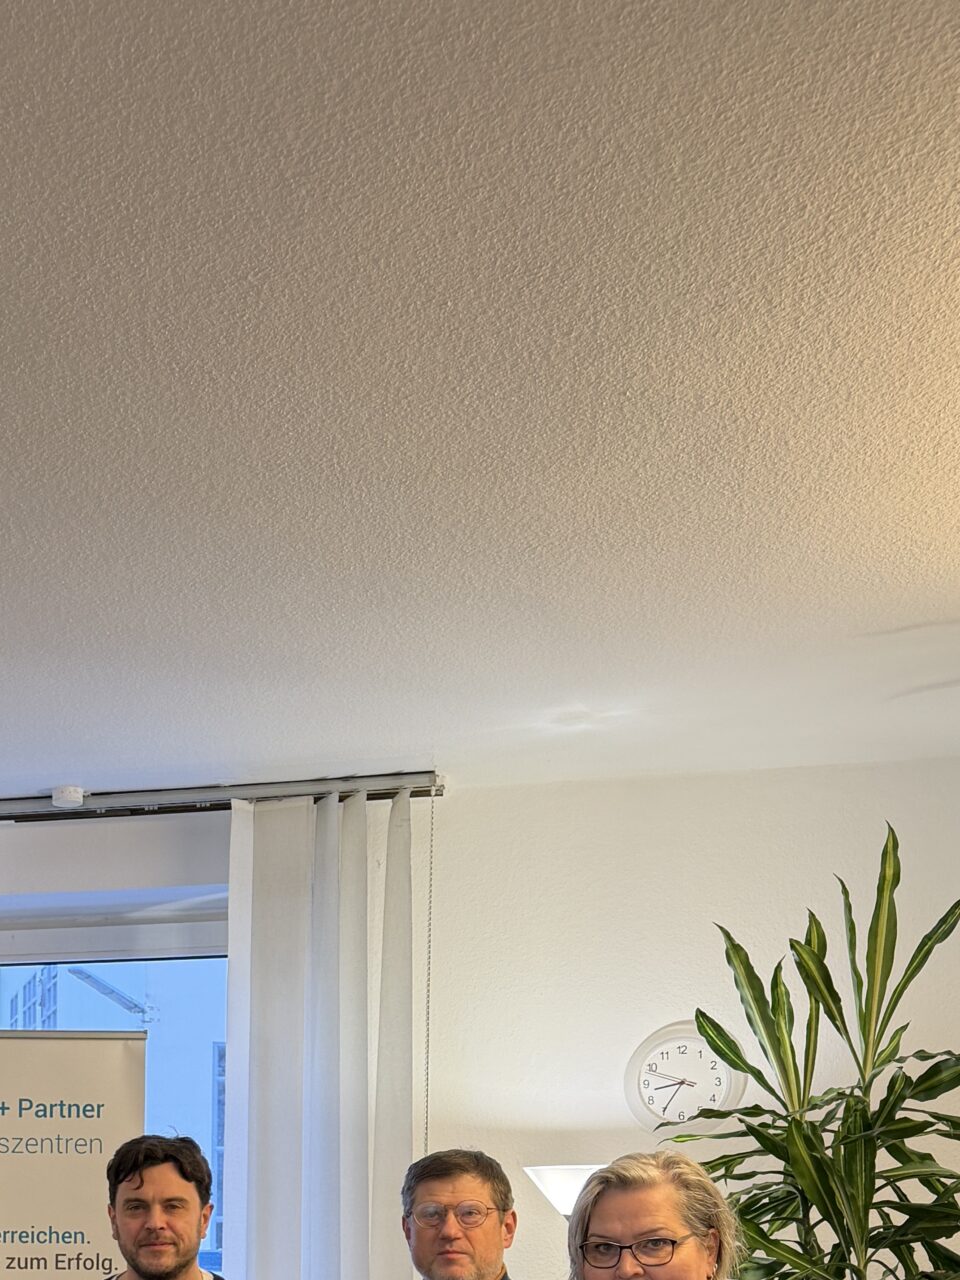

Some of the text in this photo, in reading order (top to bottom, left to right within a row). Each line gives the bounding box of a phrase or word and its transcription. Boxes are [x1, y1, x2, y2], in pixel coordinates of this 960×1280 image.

[677, 1045, 688, 1055] 12
[698, 1050, 703, 1059] 1
[660, 1051, 670, 1061] 11
[647, 1063, 658, 1073] 10
[710, 1061, 718, 1070] 2
[643, 1079, 650, 1089] 9
[715, 1077, 722, 1087] 3
[647, 1096, 655, 1105] 8
[709, 1094, 717, 1103] 4
[18, 1098, 105, 1119] Partner
[678, 1111, 685, 1121] 6
[5, 1256, 48, 1271] zum
[54, 1252, 119, 1275] Erfolg.
